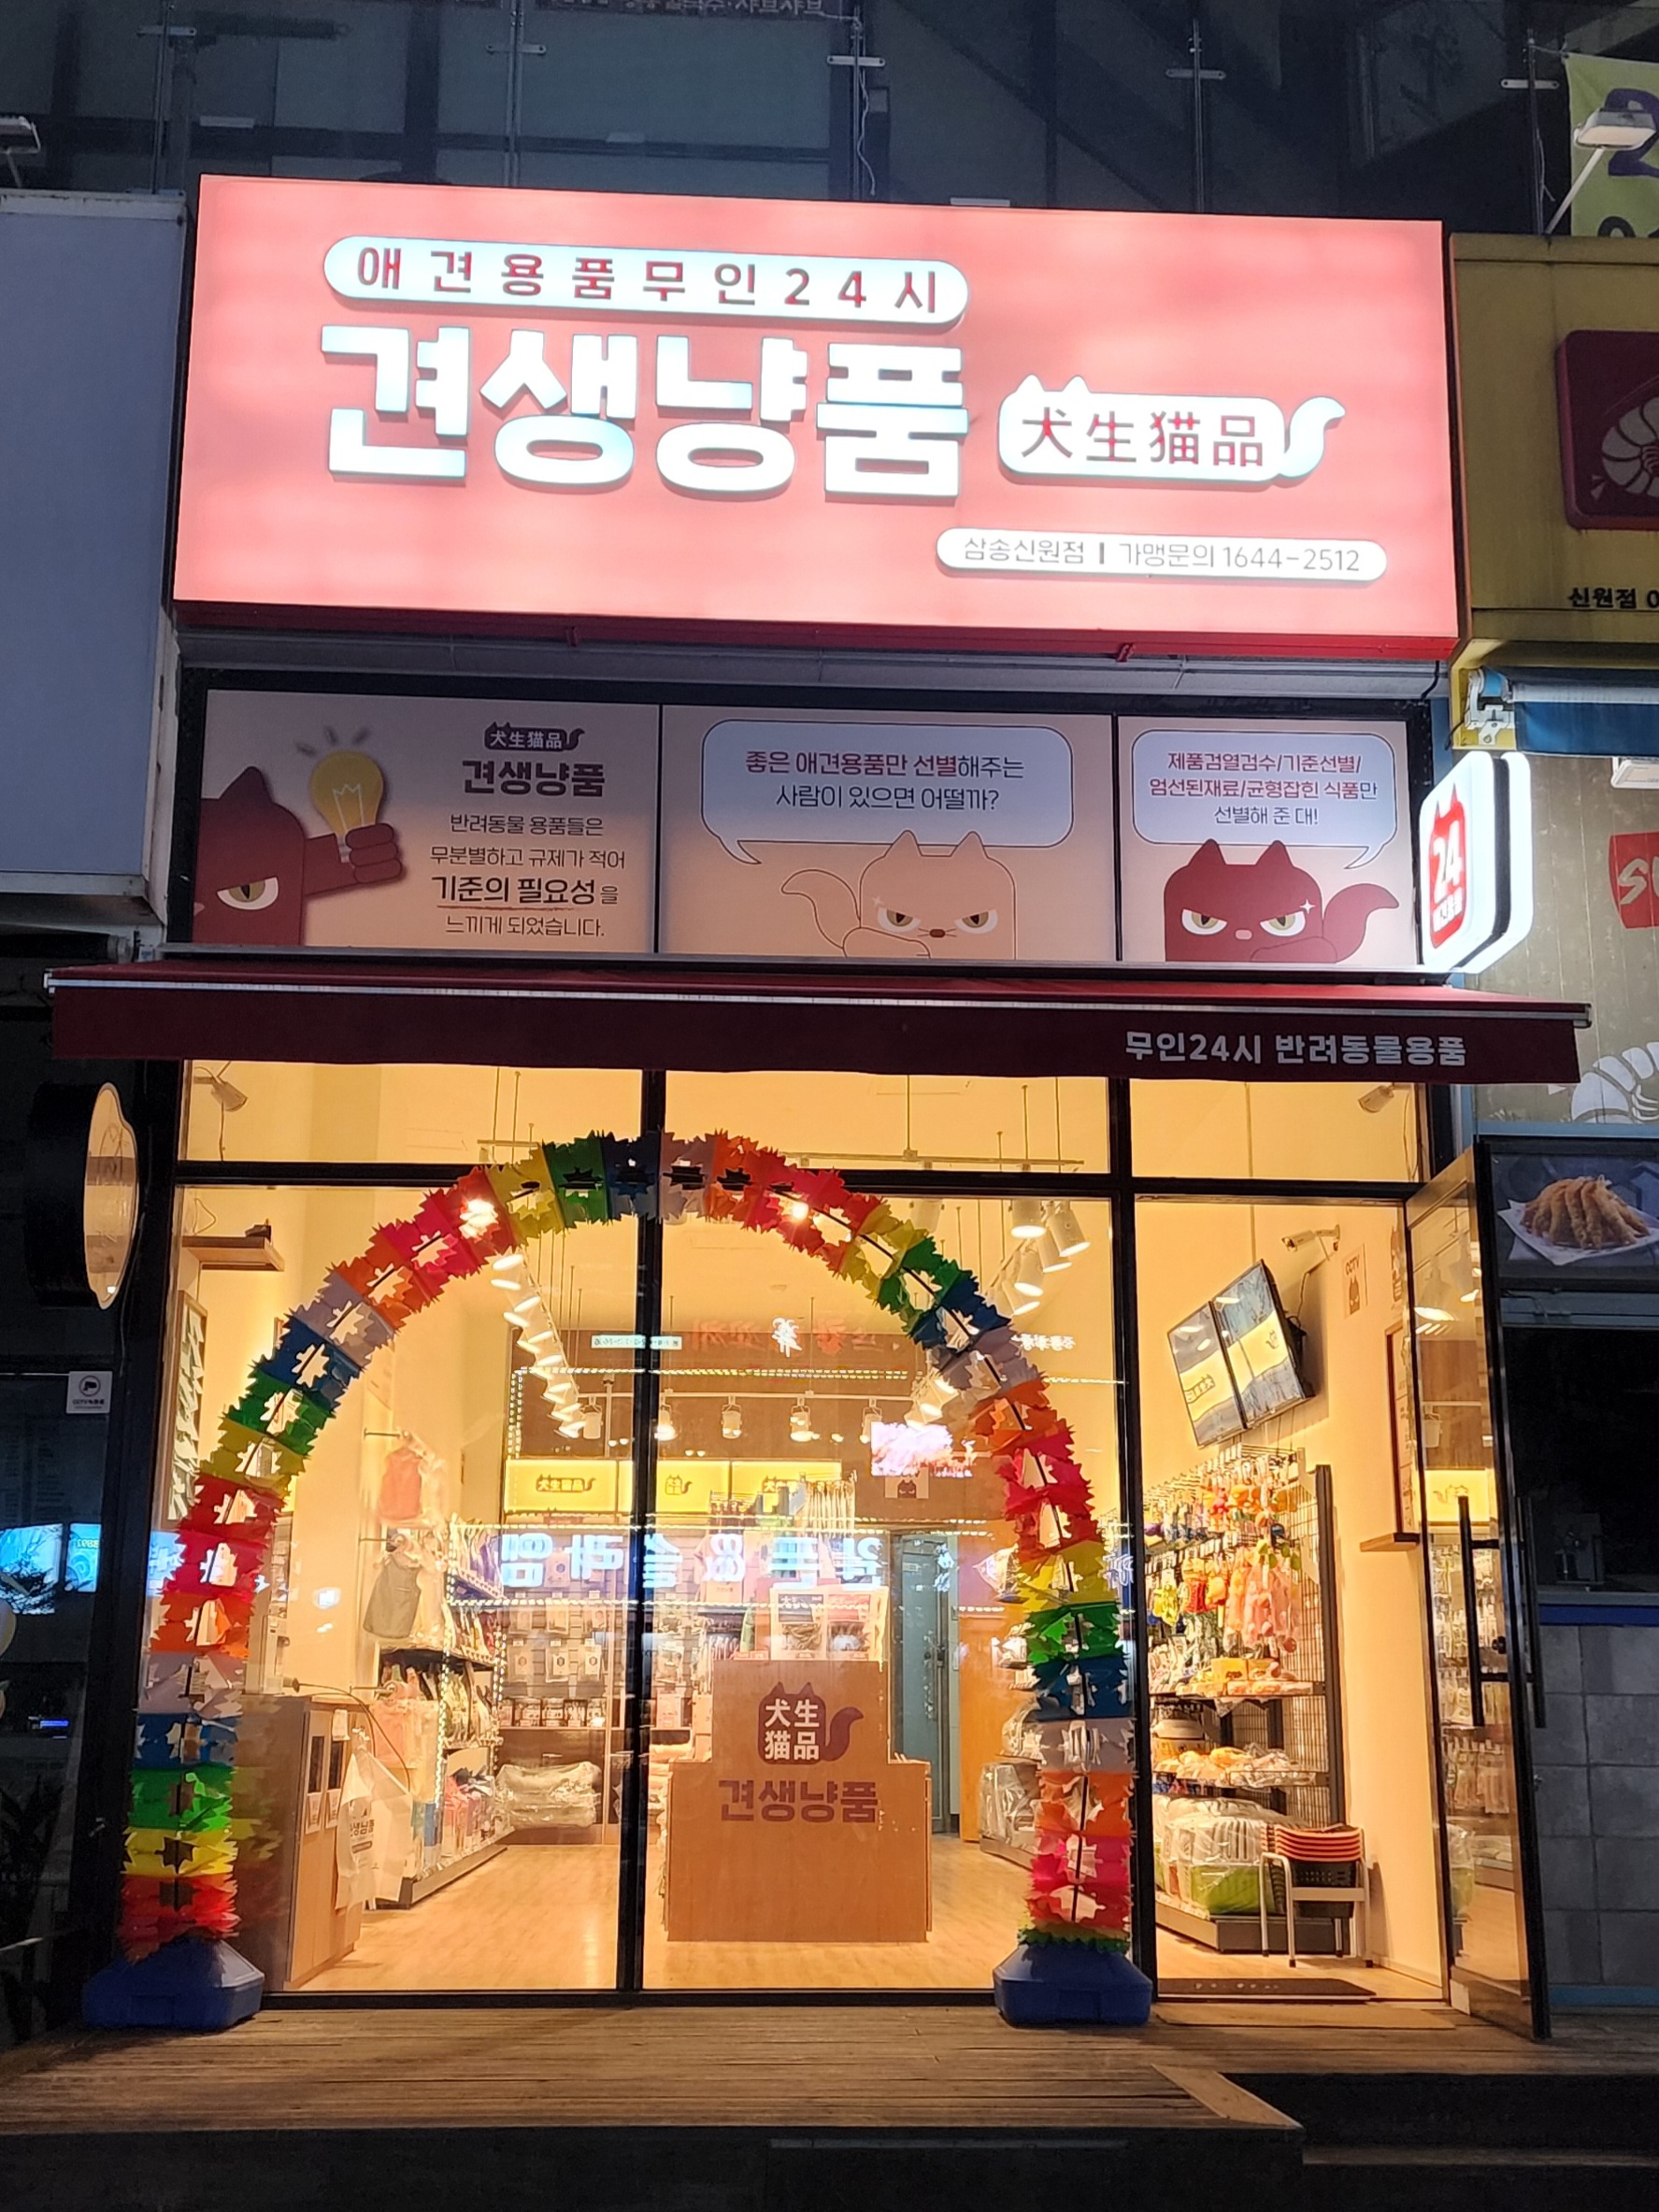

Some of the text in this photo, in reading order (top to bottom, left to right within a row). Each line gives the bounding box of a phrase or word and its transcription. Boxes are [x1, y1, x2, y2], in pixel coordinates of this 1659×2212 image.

[321, 324, 970, 501] 견생냥품
[1022, 407, 1264, 467] 犬生猫品
[964, 537, 1361, 572] 삼송신원점 가맹문의 1644-2512
[1567, 587, 1637, 609] 신원점
[490, 731, 562, 749] 犬生猫品
[462, 760, 606, 797] 견생냥품
[745, 751, 1024, 779] 좋은 애견용품만 선별해주는
[776, 785, 999, 810] 사람이 있으면 어떨까?
[1150, 778, 1378, 800] 엄선된재료/균형잡힌 식품만
[451, 814, 605, 836] 반려동물 용품들은
[1214, 806, 1268, 824] 선별해
[430, 846, 625, 869] 무분별하고 규제가 적어
[1433, 821, 1463, 905] 24
[431, 876, 509, 903] 기준의
[1619, 854, 1659, 906] S
[446, 916, 604, 937] 느끼게 되었습니다.
[1125, 1031, 1466, 1066] 무인24시 반려동물용품
[765, 1699, 820, 1728] 犬生
[765, 1731, 820, 1761] 猫品
[719, 1779, 878, 1822] 견생냥품
